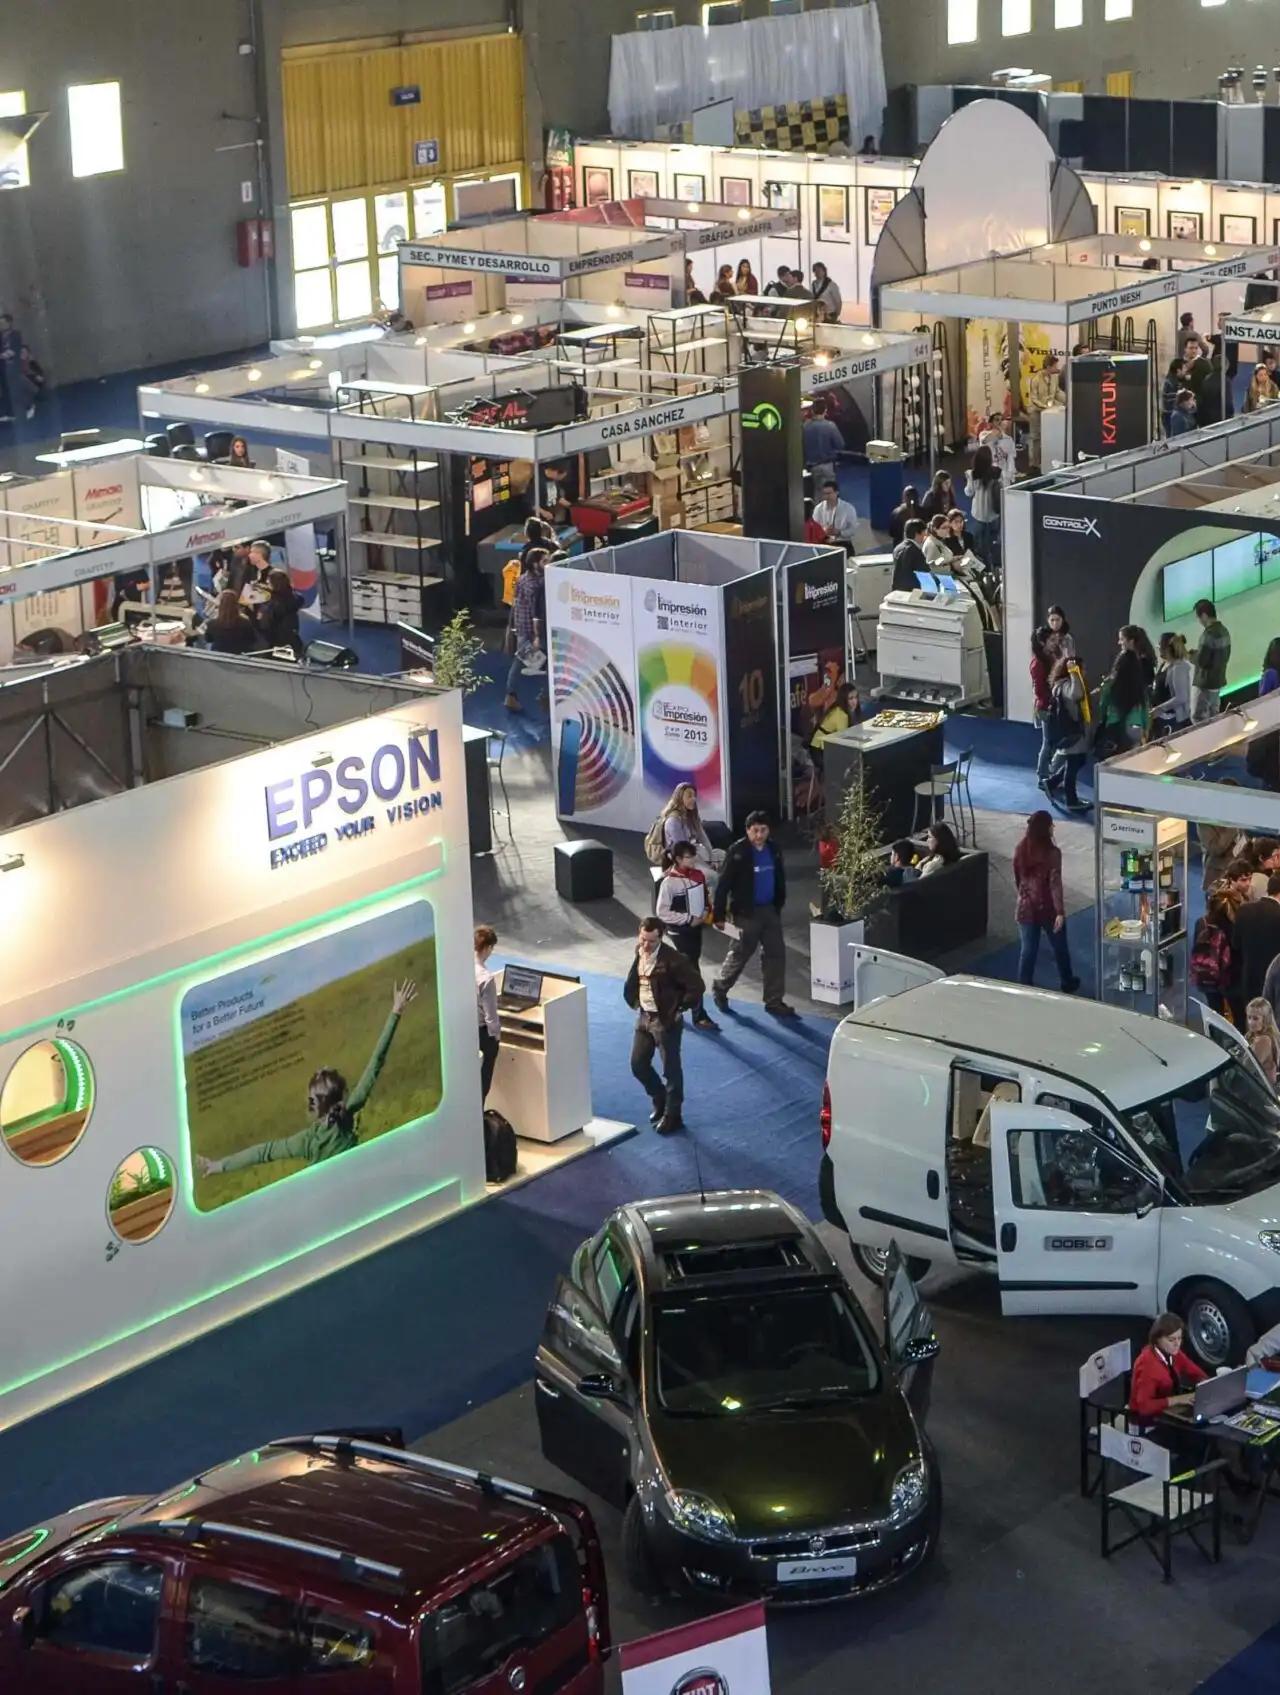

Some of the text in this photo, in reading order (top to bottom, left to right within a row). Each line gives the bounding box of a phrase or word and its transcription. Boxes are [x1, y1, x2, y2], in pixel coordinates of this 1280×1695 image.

[409, 249, 434, 263] SEC.
[478, 255, 551, 273] DESARROLLO
[568, 250, 635, 272] EMPRENDEDOR
[1217, 262, 1247, 278] CENTER
[1091, 295, 1119, 314] PUNTO
[1119, 290, 1142, 307] MESH
[812, 345, 929, 385] SELLOS QUER 141
[1102, 371, 1117, 444] KATUN
[601, 407, 685, 440] CASA SANCHEZ
[186, 528, 226, 547] Mimaki
[684, 728, 708, 742] 2013
[264, 729, 441, 842] EPSON
[270, 791, 443, 870] EXCEED YOUR VISION
[191, 989, 254, 1021] Better Products
[192, 999, 265, 1035] for a Better Future
[1051, 1239, 1106, 1249] DOBLO
